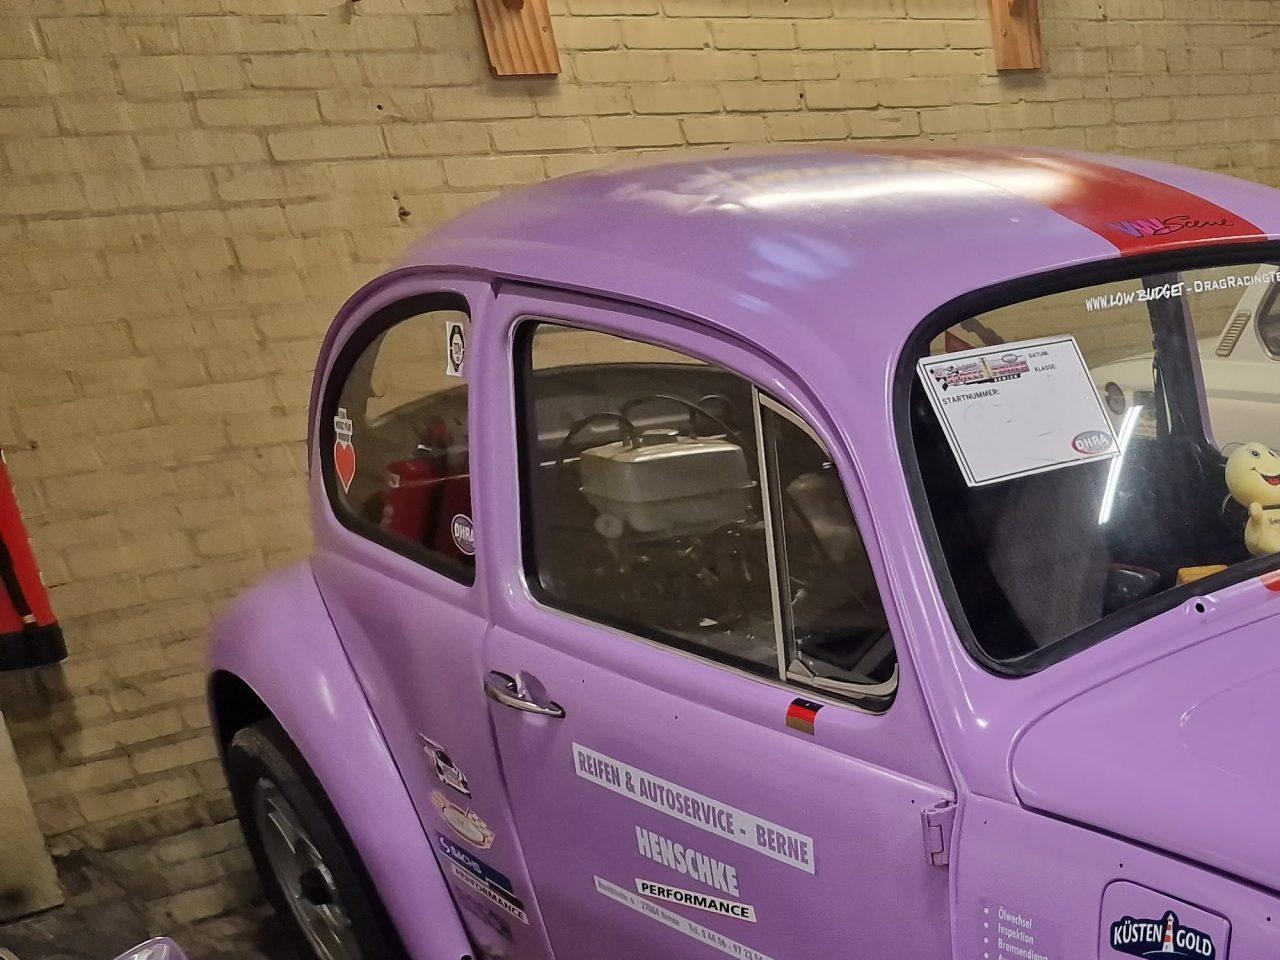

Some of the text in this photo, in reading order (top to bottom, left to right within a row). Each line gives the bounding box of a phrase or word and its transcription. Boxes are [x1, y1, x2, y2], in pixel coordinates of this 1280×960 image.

[942, 388, 1001, 405] STARTNUMMER:
[578, 751, 621, 788] REIFEN
[624, 771, 636, 794] &
[639, 777, 735, 836] AUTOSERVICE
[755, 824, 809, 866] BERNE
[635, 825, 740, 898] HENSCHKE
[641, 881, 750, 919] PERFORMANCE
[998, 922, 1034, 945] Inspektion
[1113, 919, 1212, 957] KÜSTEN GOLD
